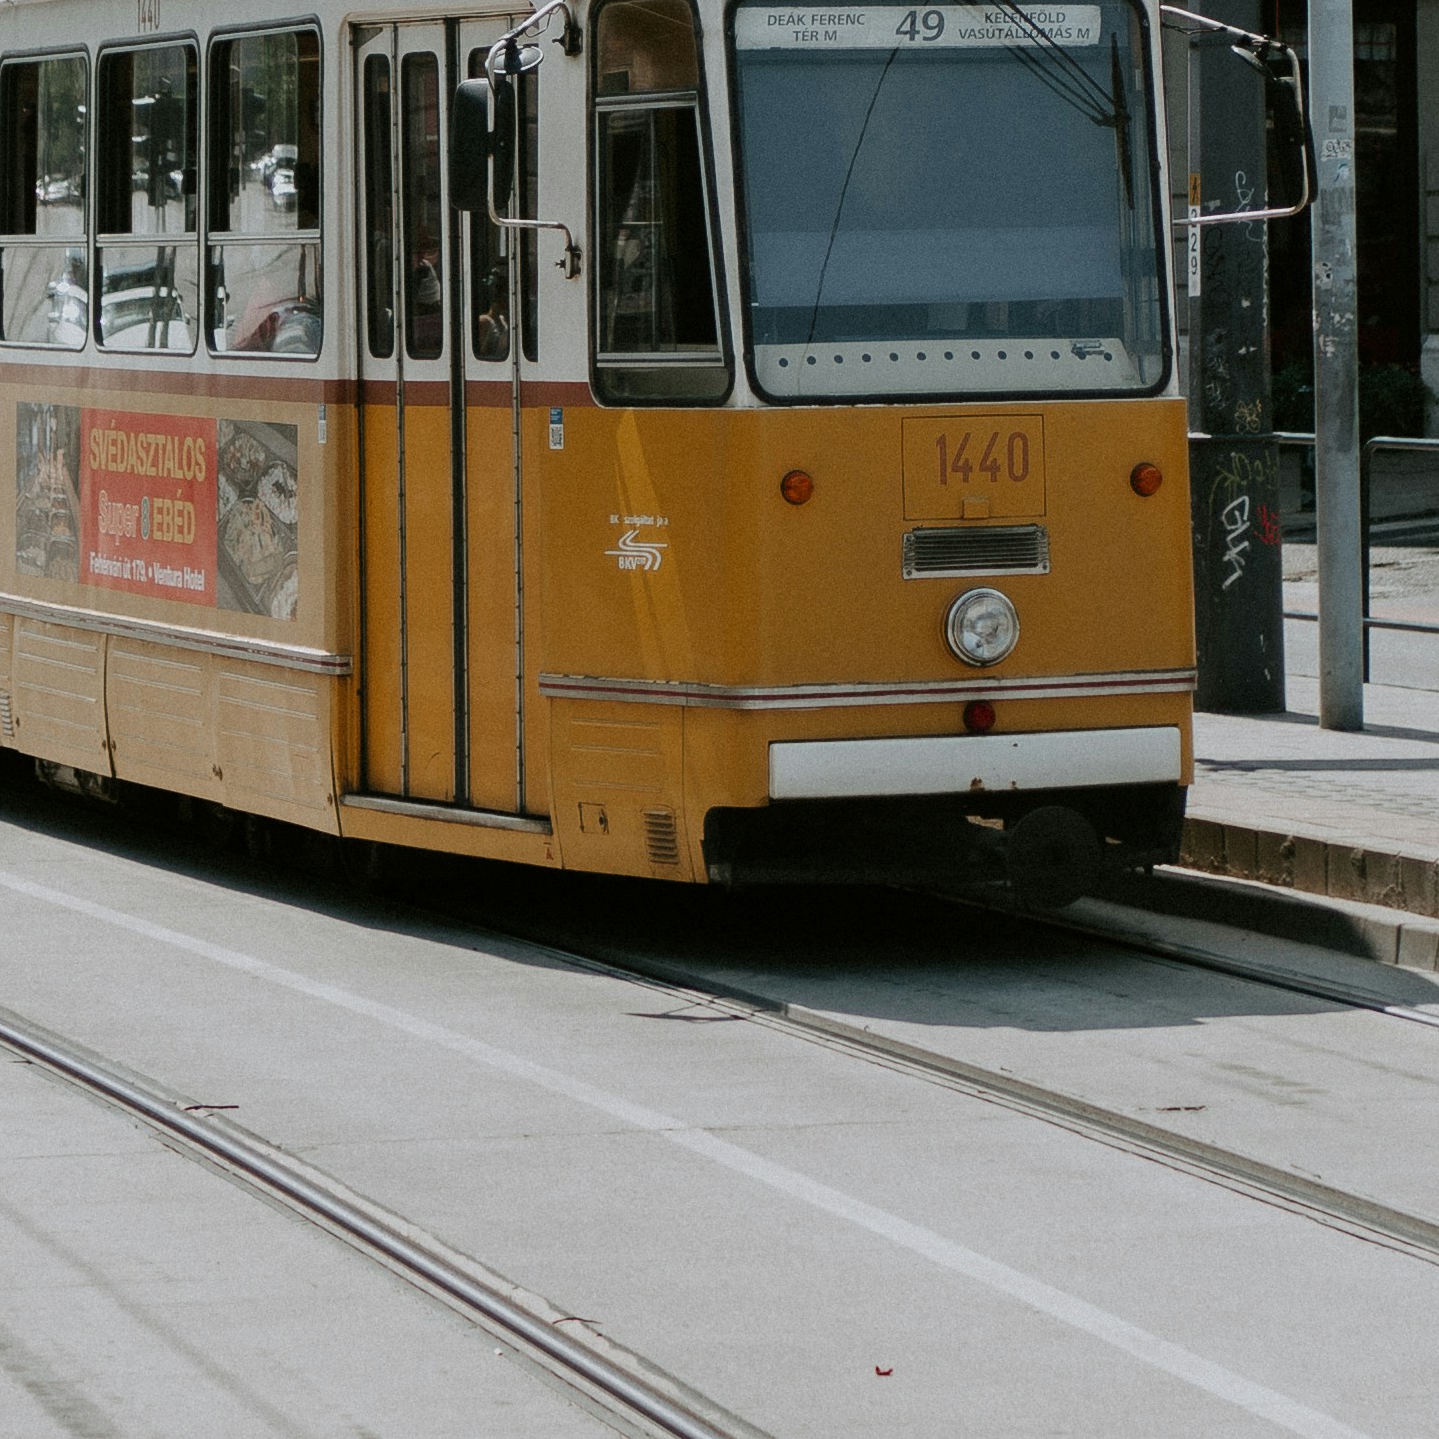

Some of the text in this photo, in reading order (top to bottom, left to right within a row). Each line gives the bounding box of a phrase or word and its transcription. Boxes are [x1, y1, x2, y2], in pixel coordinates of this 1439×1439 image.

[767, 12, 866, 26] DEÁK FERENC
[895, 10, 945, 41] 49
[1077, 27, 1090, 39] M
[793, 28, 837, 41] TÉR M
[89, 419, 206, 482] SVÉDASZTALOS
[936, 432, 1029, 485] 1440
[98, 490, 139, 546] Super
[153, 489, 195, 544] EBÉD
[184, 566, 205, 591] Hotel
